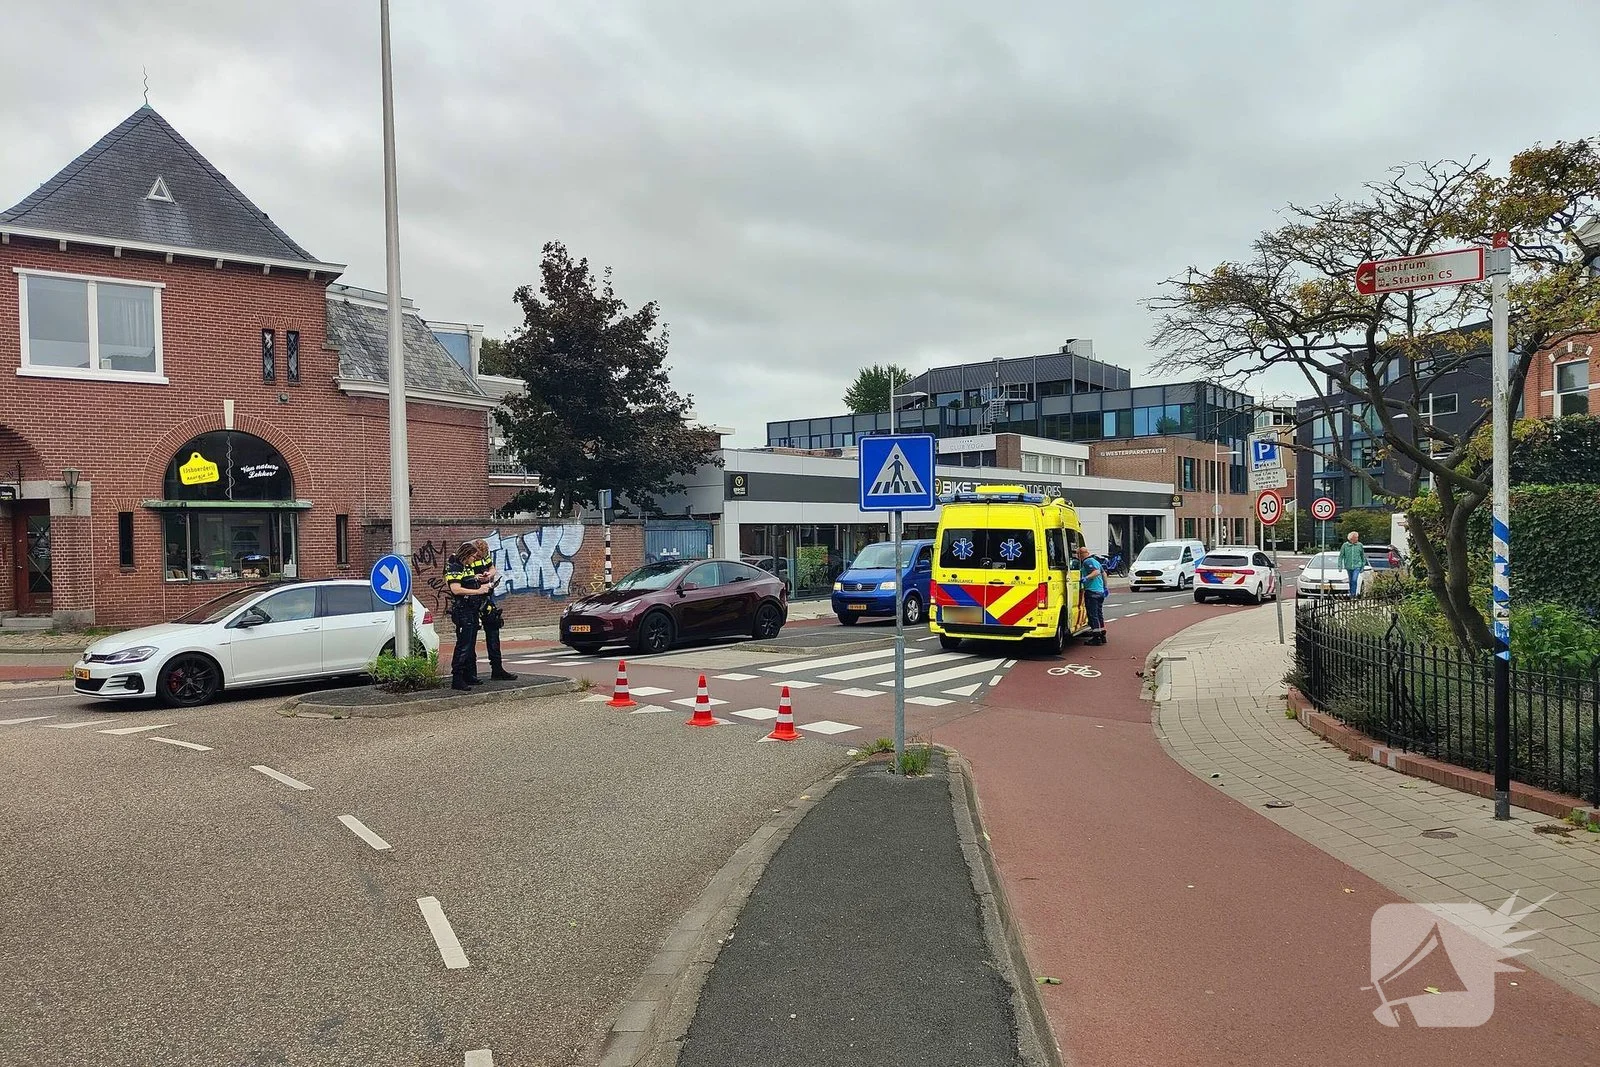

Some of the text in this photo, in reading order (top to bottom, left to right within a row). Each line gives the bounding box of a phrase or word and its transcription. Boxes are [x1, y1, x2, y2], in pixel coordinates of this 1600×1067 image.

[1377, 261, 1426, 274] Centrum
[1392, 270, 1453, 285] Station CS
[950, 442, 985, 451] CLUB YOGA
[1258, 442, 1271, 459] P
[942, 480, 972, 494] BIKE
[1044, 485, 1062, 497] VRIES
[1261, 500, 1277, 515] 30
[1317, 504, 1331, 513] 30
